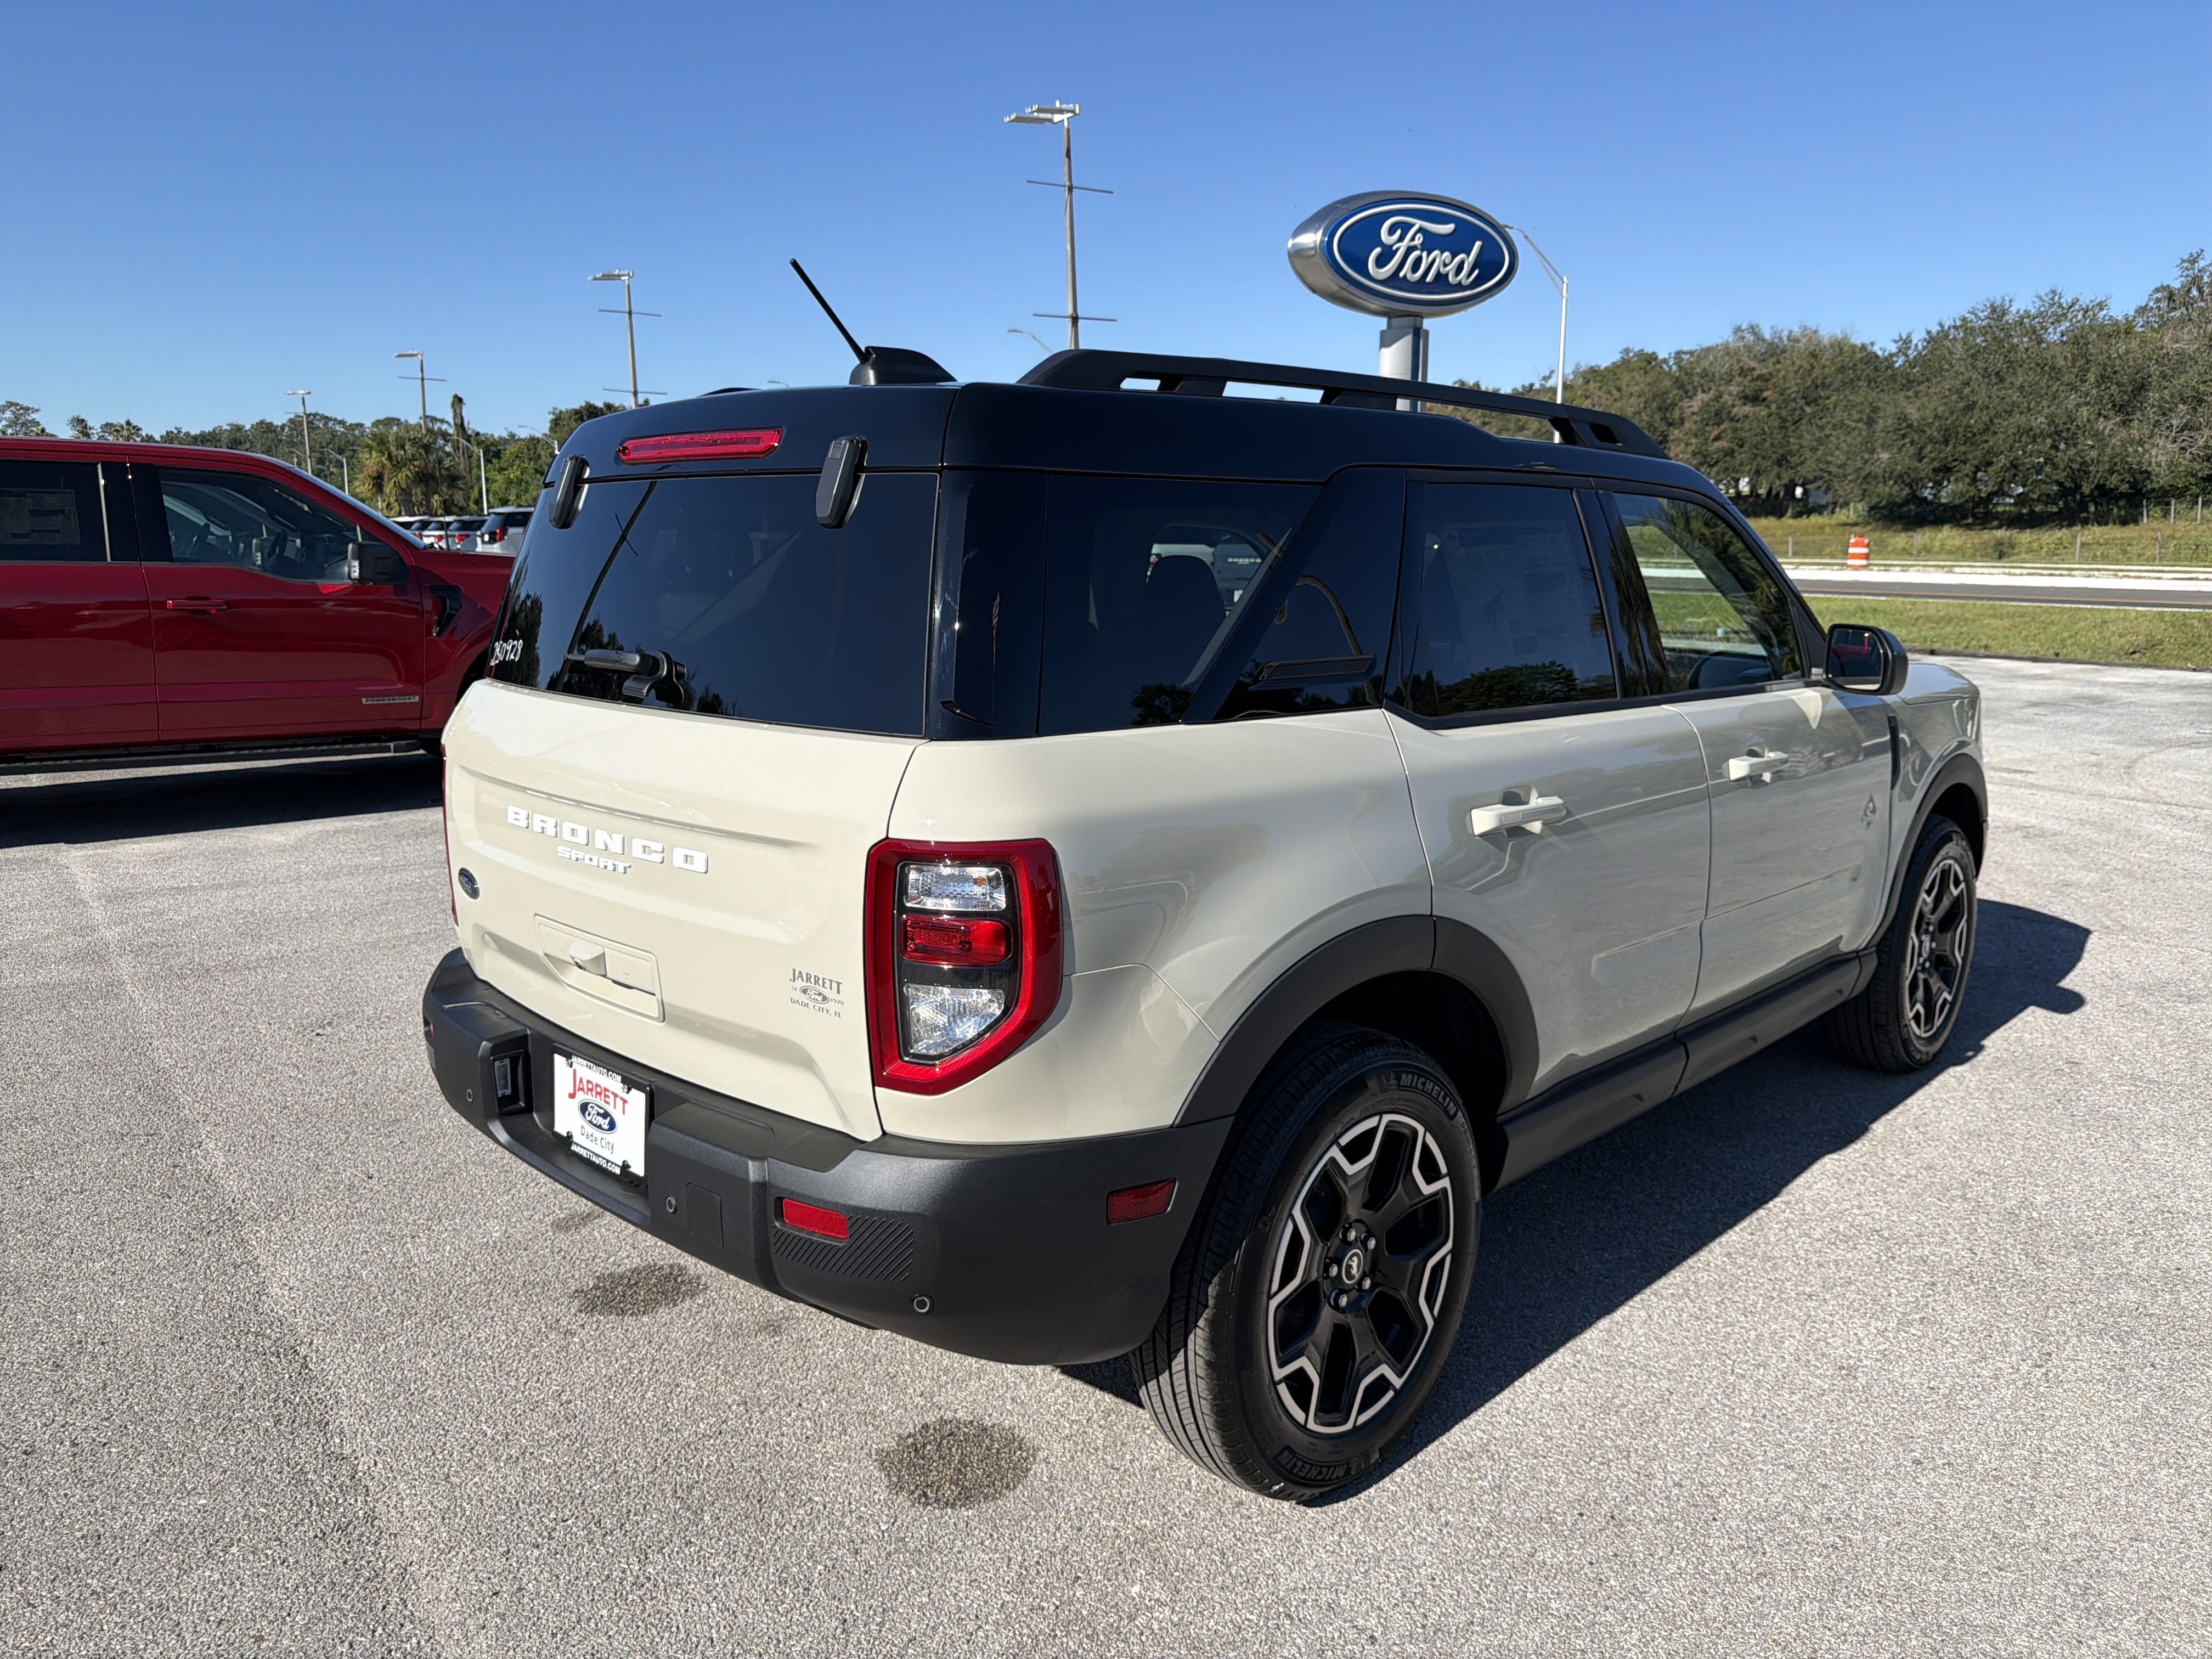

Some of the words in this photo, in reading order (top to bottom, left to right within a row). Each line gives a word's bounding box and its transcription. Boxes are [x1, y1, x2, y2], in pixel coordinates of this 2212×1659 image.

[1368, 216, 1482, 286] Ford
[490, 639, 523, 666] 250928
[507, 805, 708, 874] BRONCO
[557, 845, 631, 874] SPORT
[789, 968, 843, 995] JARRETT
[790, 997, 810, 1009] DADE
[813, 1005, 832, 1017] CITY,
[834, 1011, 843, 1019] FL
[571, 1054, 622, 1083] JARRETTAUTO.COM
[568, 1069, 628, 1115] JARRETT
[1400, 1073, 1457, 1115] MICHELIN
[585, 1103, 611, 1130] Ford
[580, 1125, 598, 1146] Dade
[600, 1137, 614, 1154] City
[571, 1142, 621, 1175] JARRETTAUTO.COM
[1277, 1448, 1348, 1480] MICHELIN
